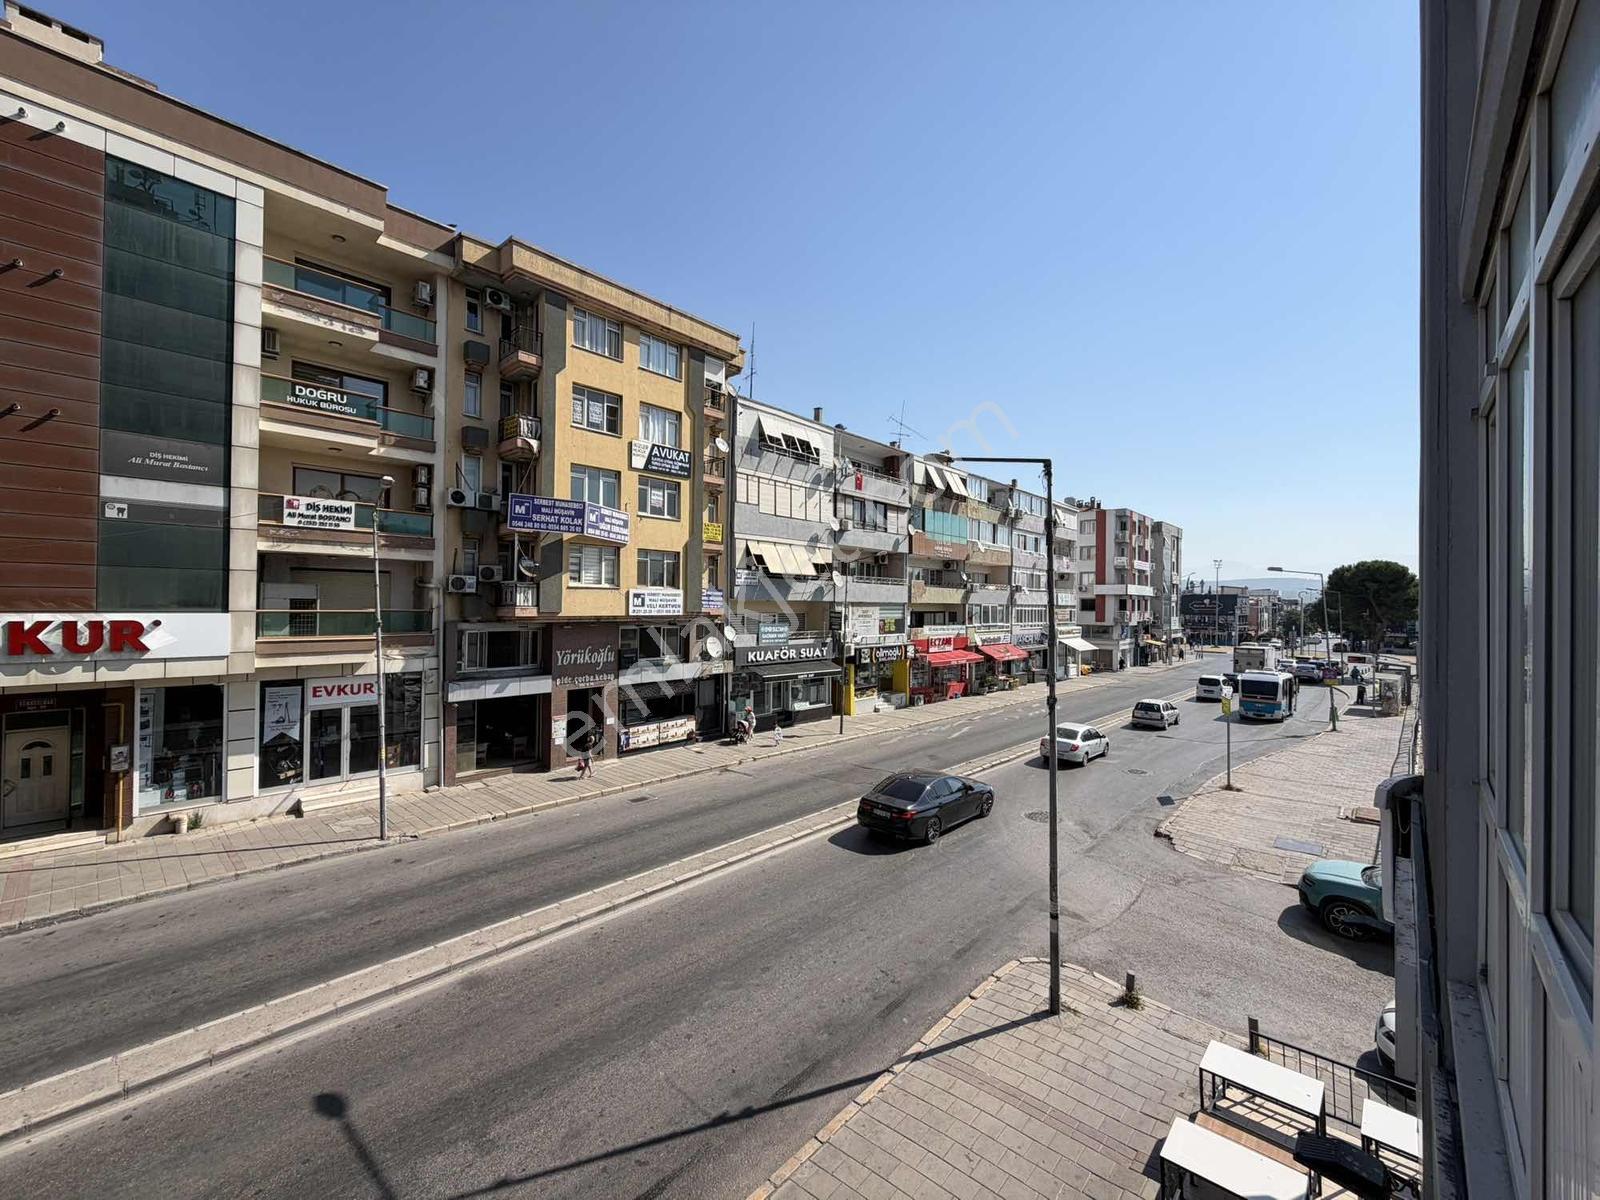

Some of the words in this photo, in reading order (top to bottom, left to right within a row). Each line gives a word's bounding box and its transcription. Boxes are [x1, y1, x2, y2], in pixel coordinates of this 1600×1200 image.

[295, 385, 347, 404] DOĞRU
[286, 395, 318, 408] HUKUK
[319, 401, 357, 414] BÜROSU
[128, 456, 142, 464] Ali
[143, 458, 172, 468] Murat
[149, 451, 162, 460] DİŞ
[652, 446, 690, 463] AVUKAT
[286, 511, 297, 519] Ali
[297, 512, 317, 520] Murat
[306, 501, 321, 513] DİŞ
[322, 503, 352, 515] HEKİMİ
[532, 513, 560, 523] SERHAT
[560, 516, 583, 526] KOLAK
[556, 643, 615, 671] Yörükoğlu
[747, 646, 797, 662] KUAFÖR
[800, 647, 828, 658] SUAT
[311, 682, 375, 699] EVKUR
